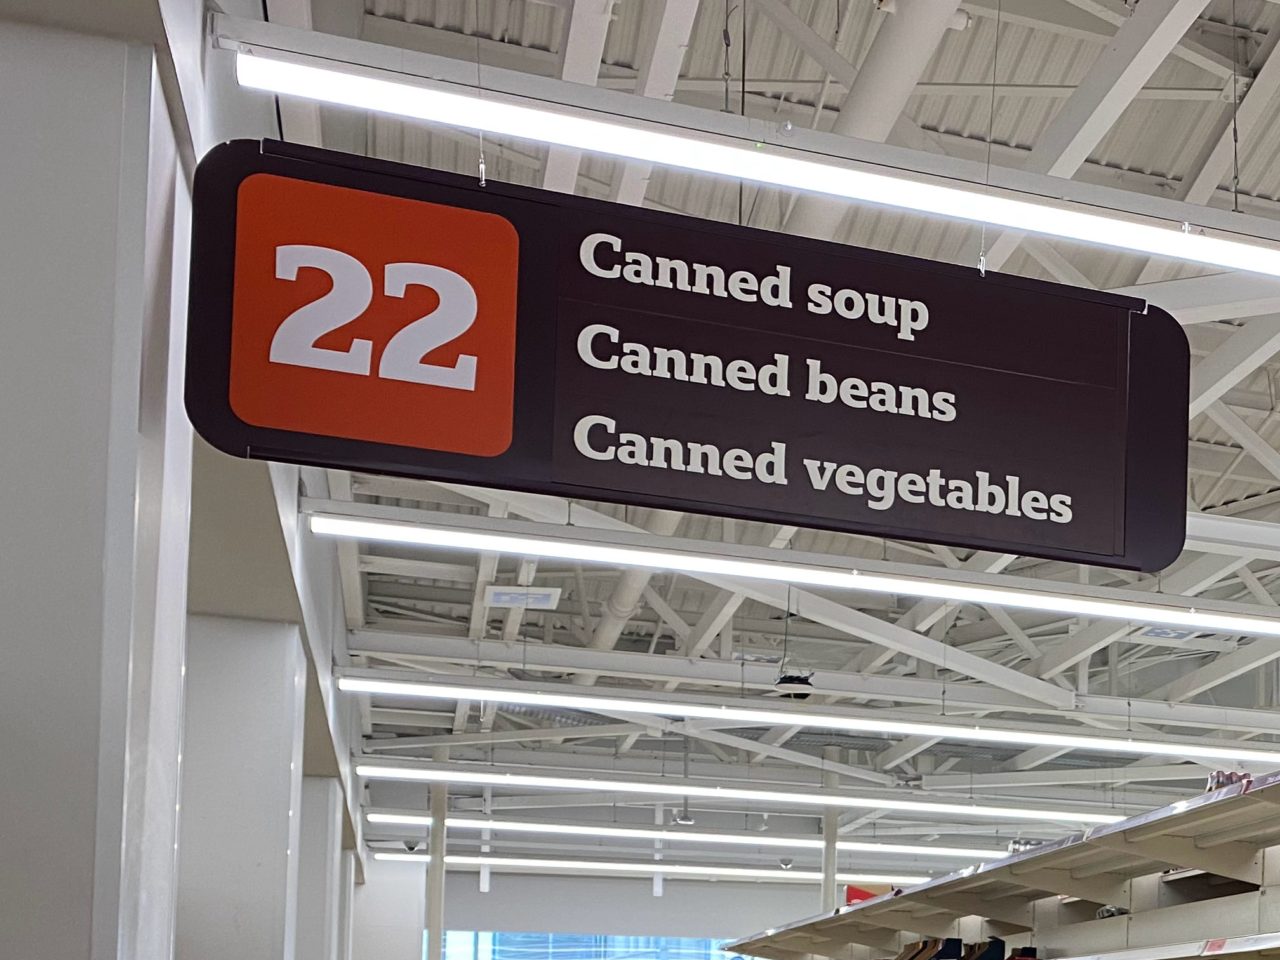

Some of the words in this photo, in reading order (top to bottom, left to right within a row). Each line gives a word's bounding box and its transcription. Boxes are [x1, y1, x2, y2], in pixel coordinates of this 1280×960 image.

[269, 243, 478, 393] 22
[578, 232, 792, 310] Canned
[806, 282, 930, 342] soup
[576, 323, 791, 399] Canned
[804, 359, 958, 422] beans
[573, 414, 788, 487] Canned
[803, 457, 1074, 526] vegetables
